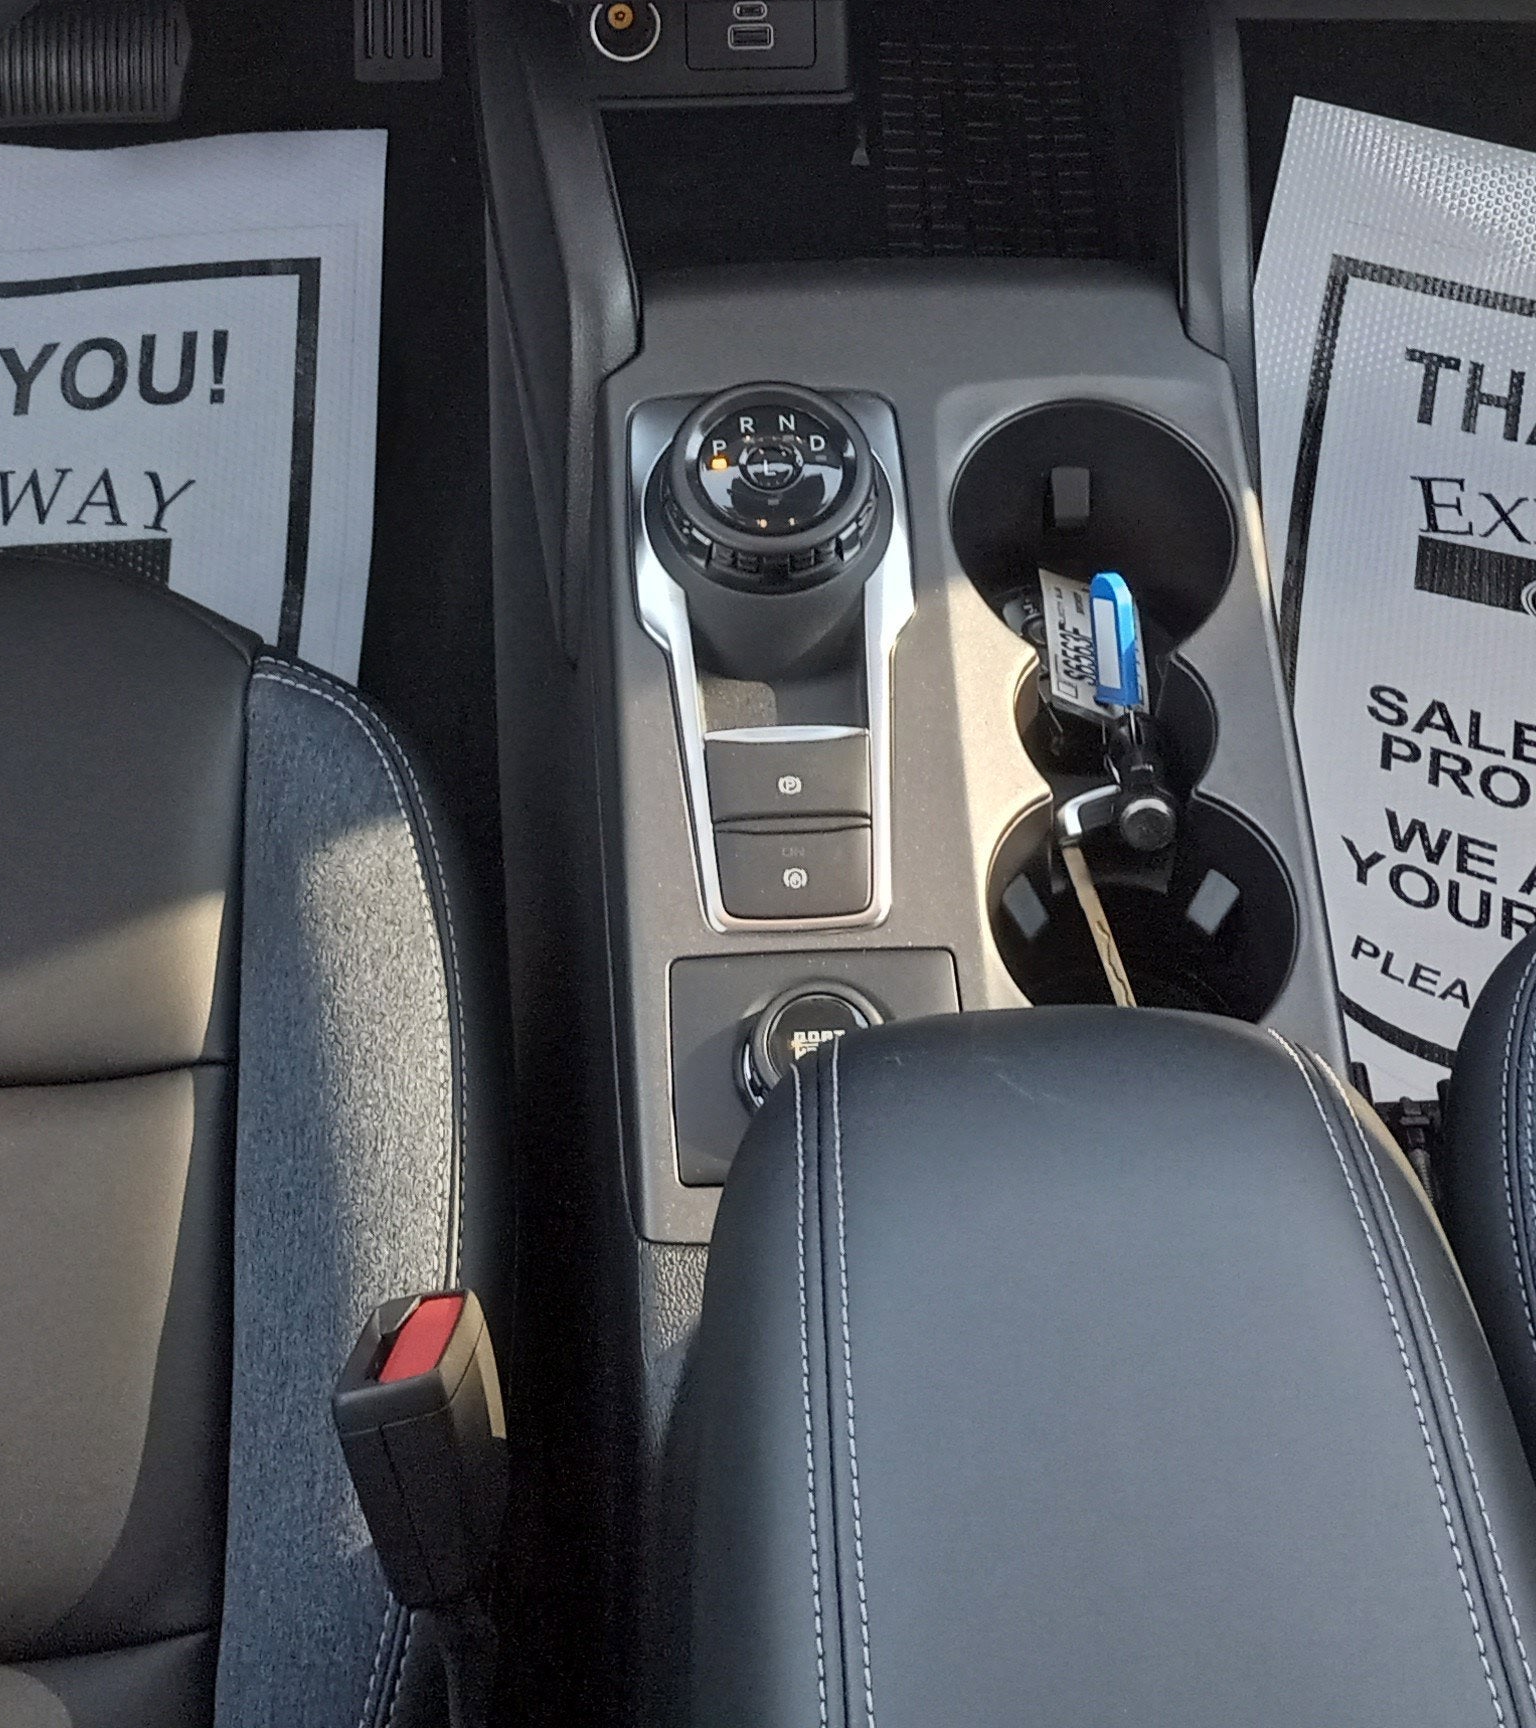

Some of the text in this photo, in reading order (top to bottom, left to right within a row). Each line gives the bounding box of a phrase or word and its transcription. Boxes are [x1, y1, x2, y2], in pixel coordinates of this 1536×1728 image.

[739, 416, 755, 433] R
[778, 413, 795, 431] N
[712, 439, 727, 456] P
[809, 434, 825, 451] D
[763, 459, 776, 476] L
[1385, 808, 1497, 885] WE
[1351, 935, 1471, 1009] PLEA
